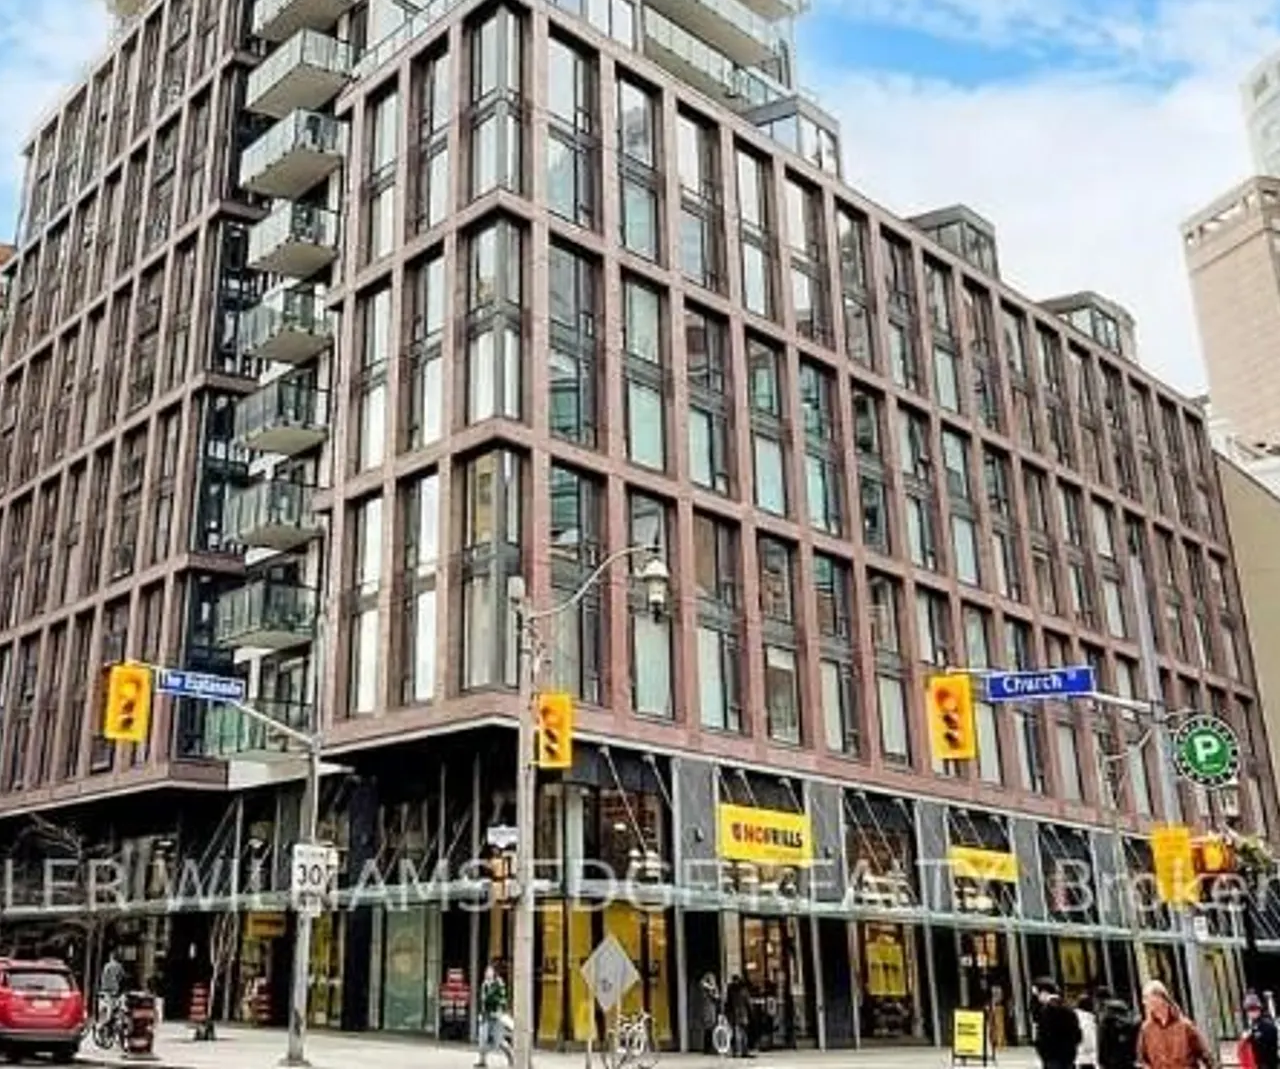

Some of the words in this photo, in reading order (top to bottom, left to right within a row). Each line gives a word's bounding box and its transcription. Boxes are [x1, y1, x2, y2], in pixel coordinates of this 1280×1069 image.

[1003, 674, 1062, 693] Church
[1194, 735, 1220, 762] P
[297, 864, 322, 886] 30
